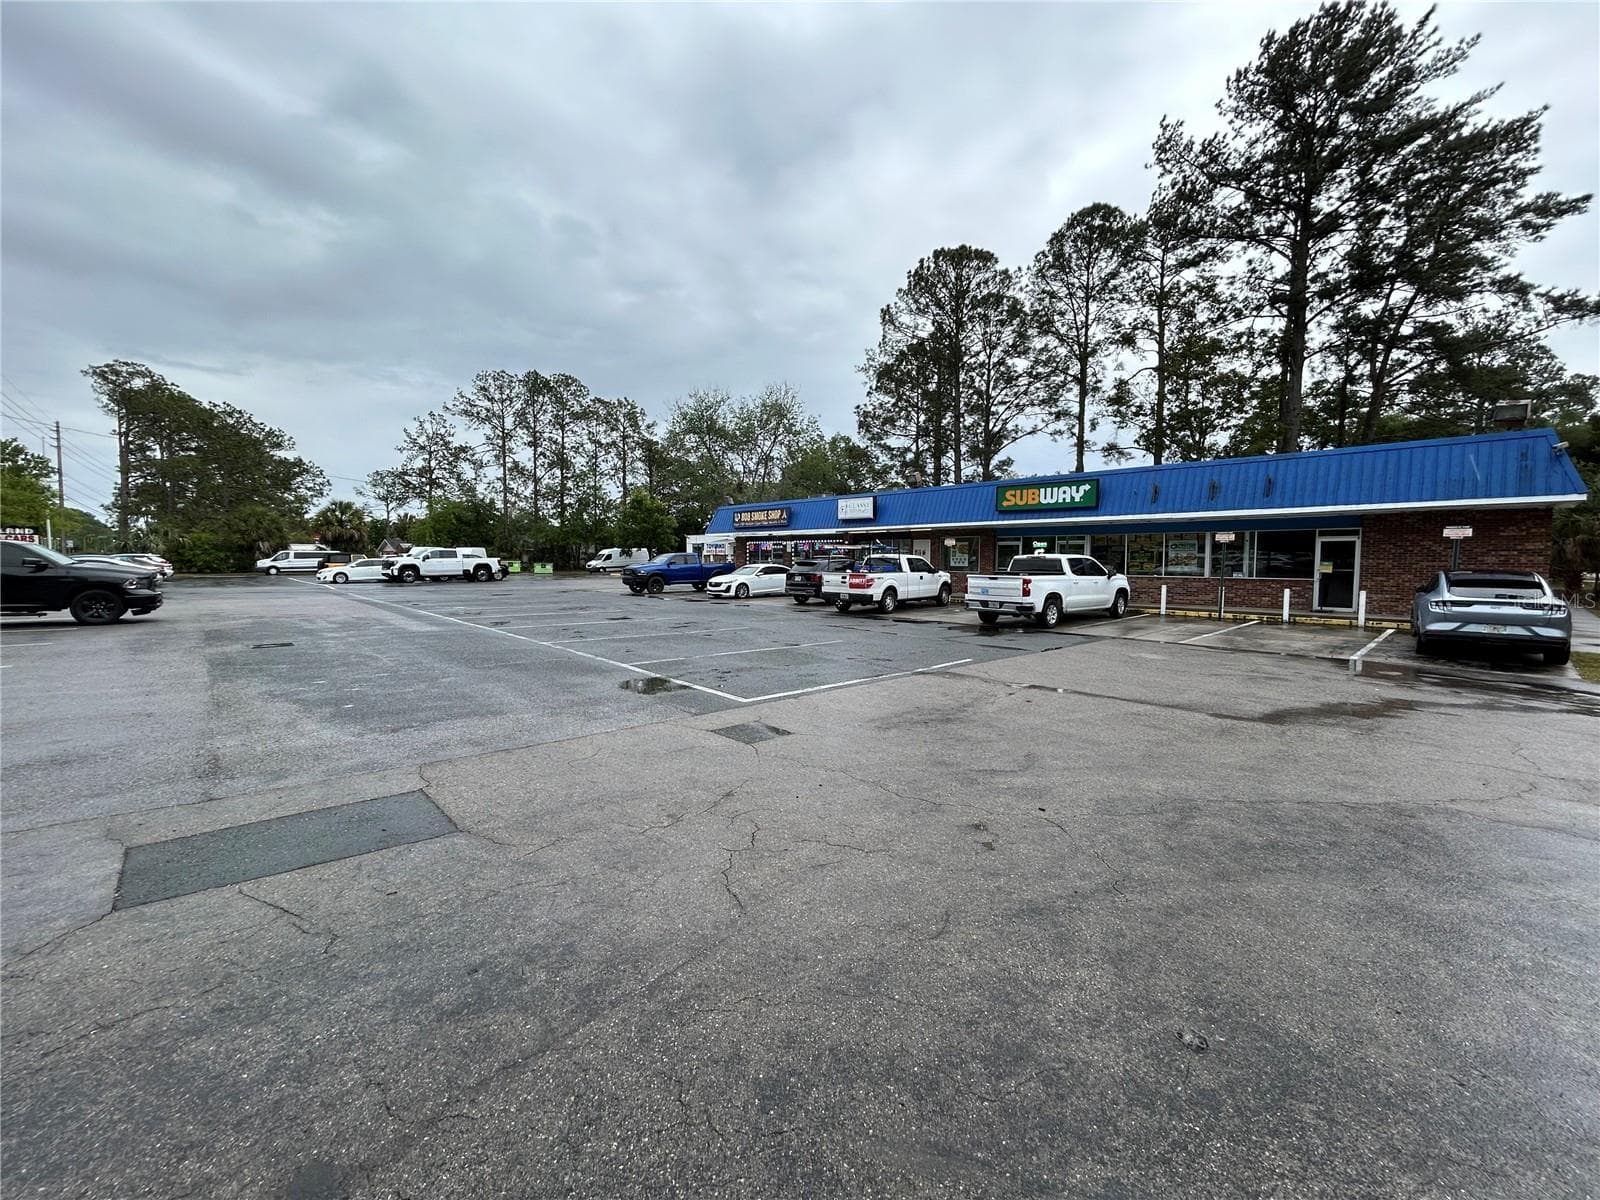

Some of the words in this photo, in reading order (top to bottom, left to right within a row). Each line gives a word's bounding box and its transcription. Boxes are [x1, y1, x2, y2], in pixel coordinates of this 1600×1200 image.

[1002, 484, 1091, 507] SUBWAY
[768, 509, 782, 520] SHOP
[5, 535, 35, 543] CARS
